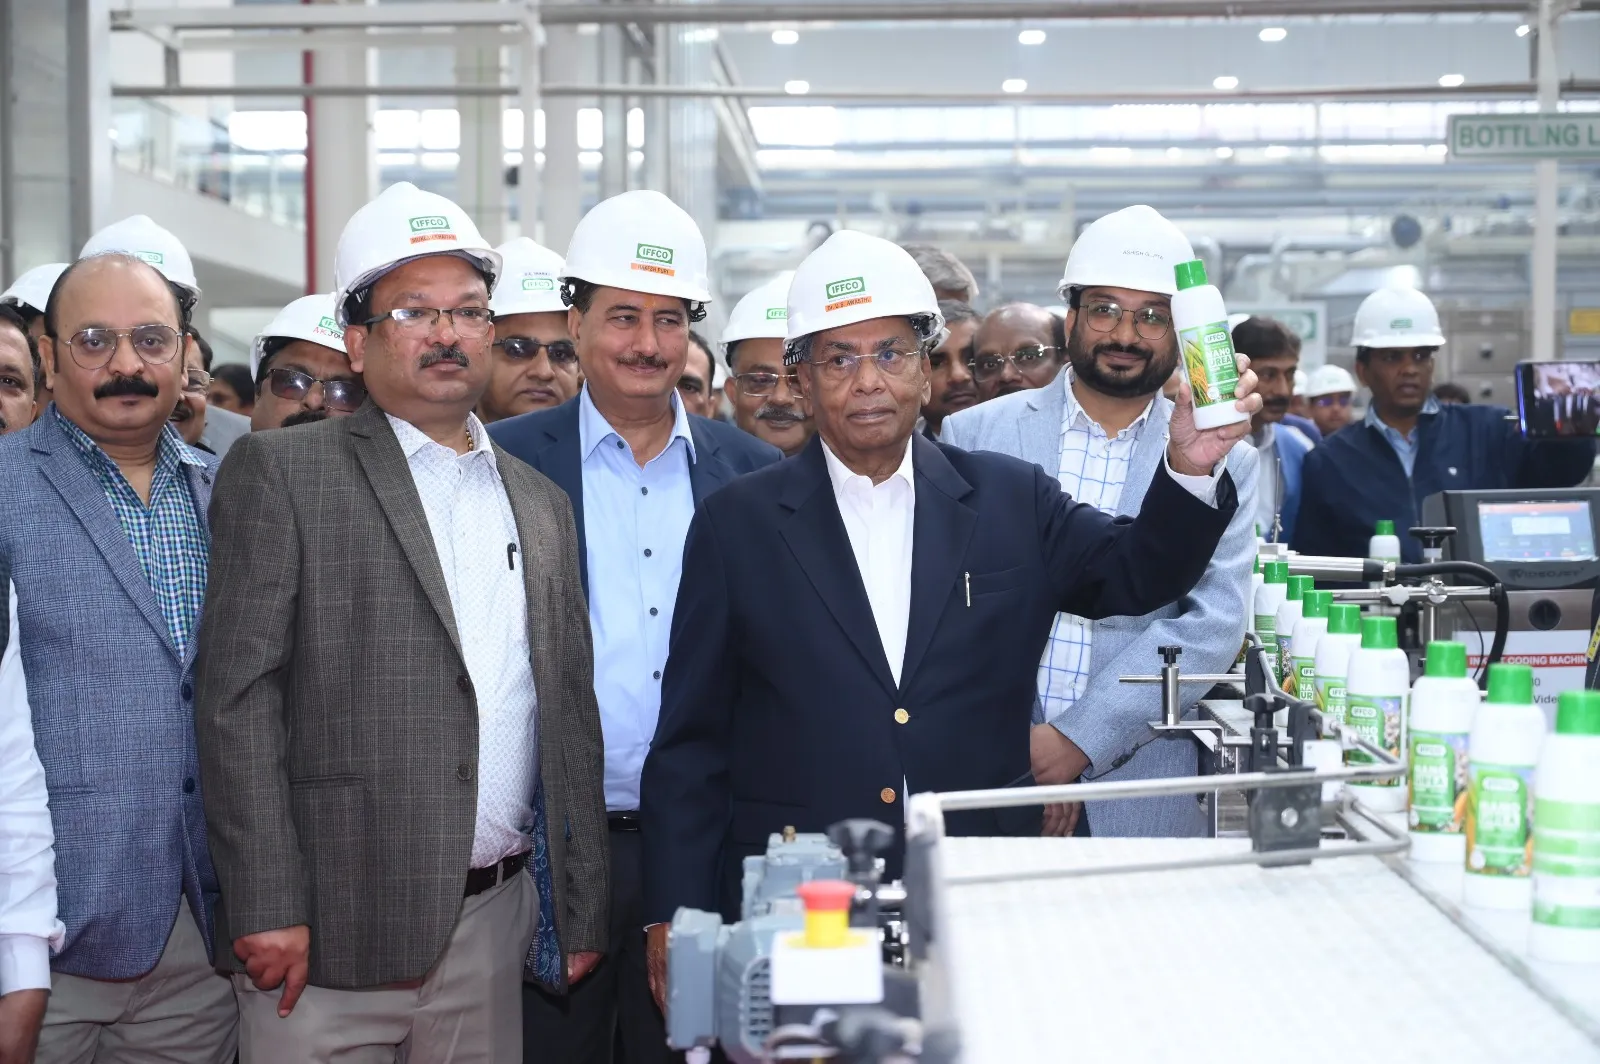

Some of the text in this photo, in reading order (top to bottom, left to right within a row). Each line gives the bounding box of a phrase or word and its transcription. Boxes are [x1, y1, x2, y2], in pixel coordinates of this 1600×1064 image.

[1459, 123, 1579, 147] BOTTLNG
[416, 218, 444, 228] IFFCO
[642, 247, 669, 259] IFFCO
[831, 281, 859, 294] IFFCO
[1207, 333, 1225, 342] IFFCO
[1507, 656, 1547, 665] CODING
[1549, 654, 1588, 665] MACHIN
[1300, 683, 1314, 692] NA
[1533, 694, 1559, 704] Vide
